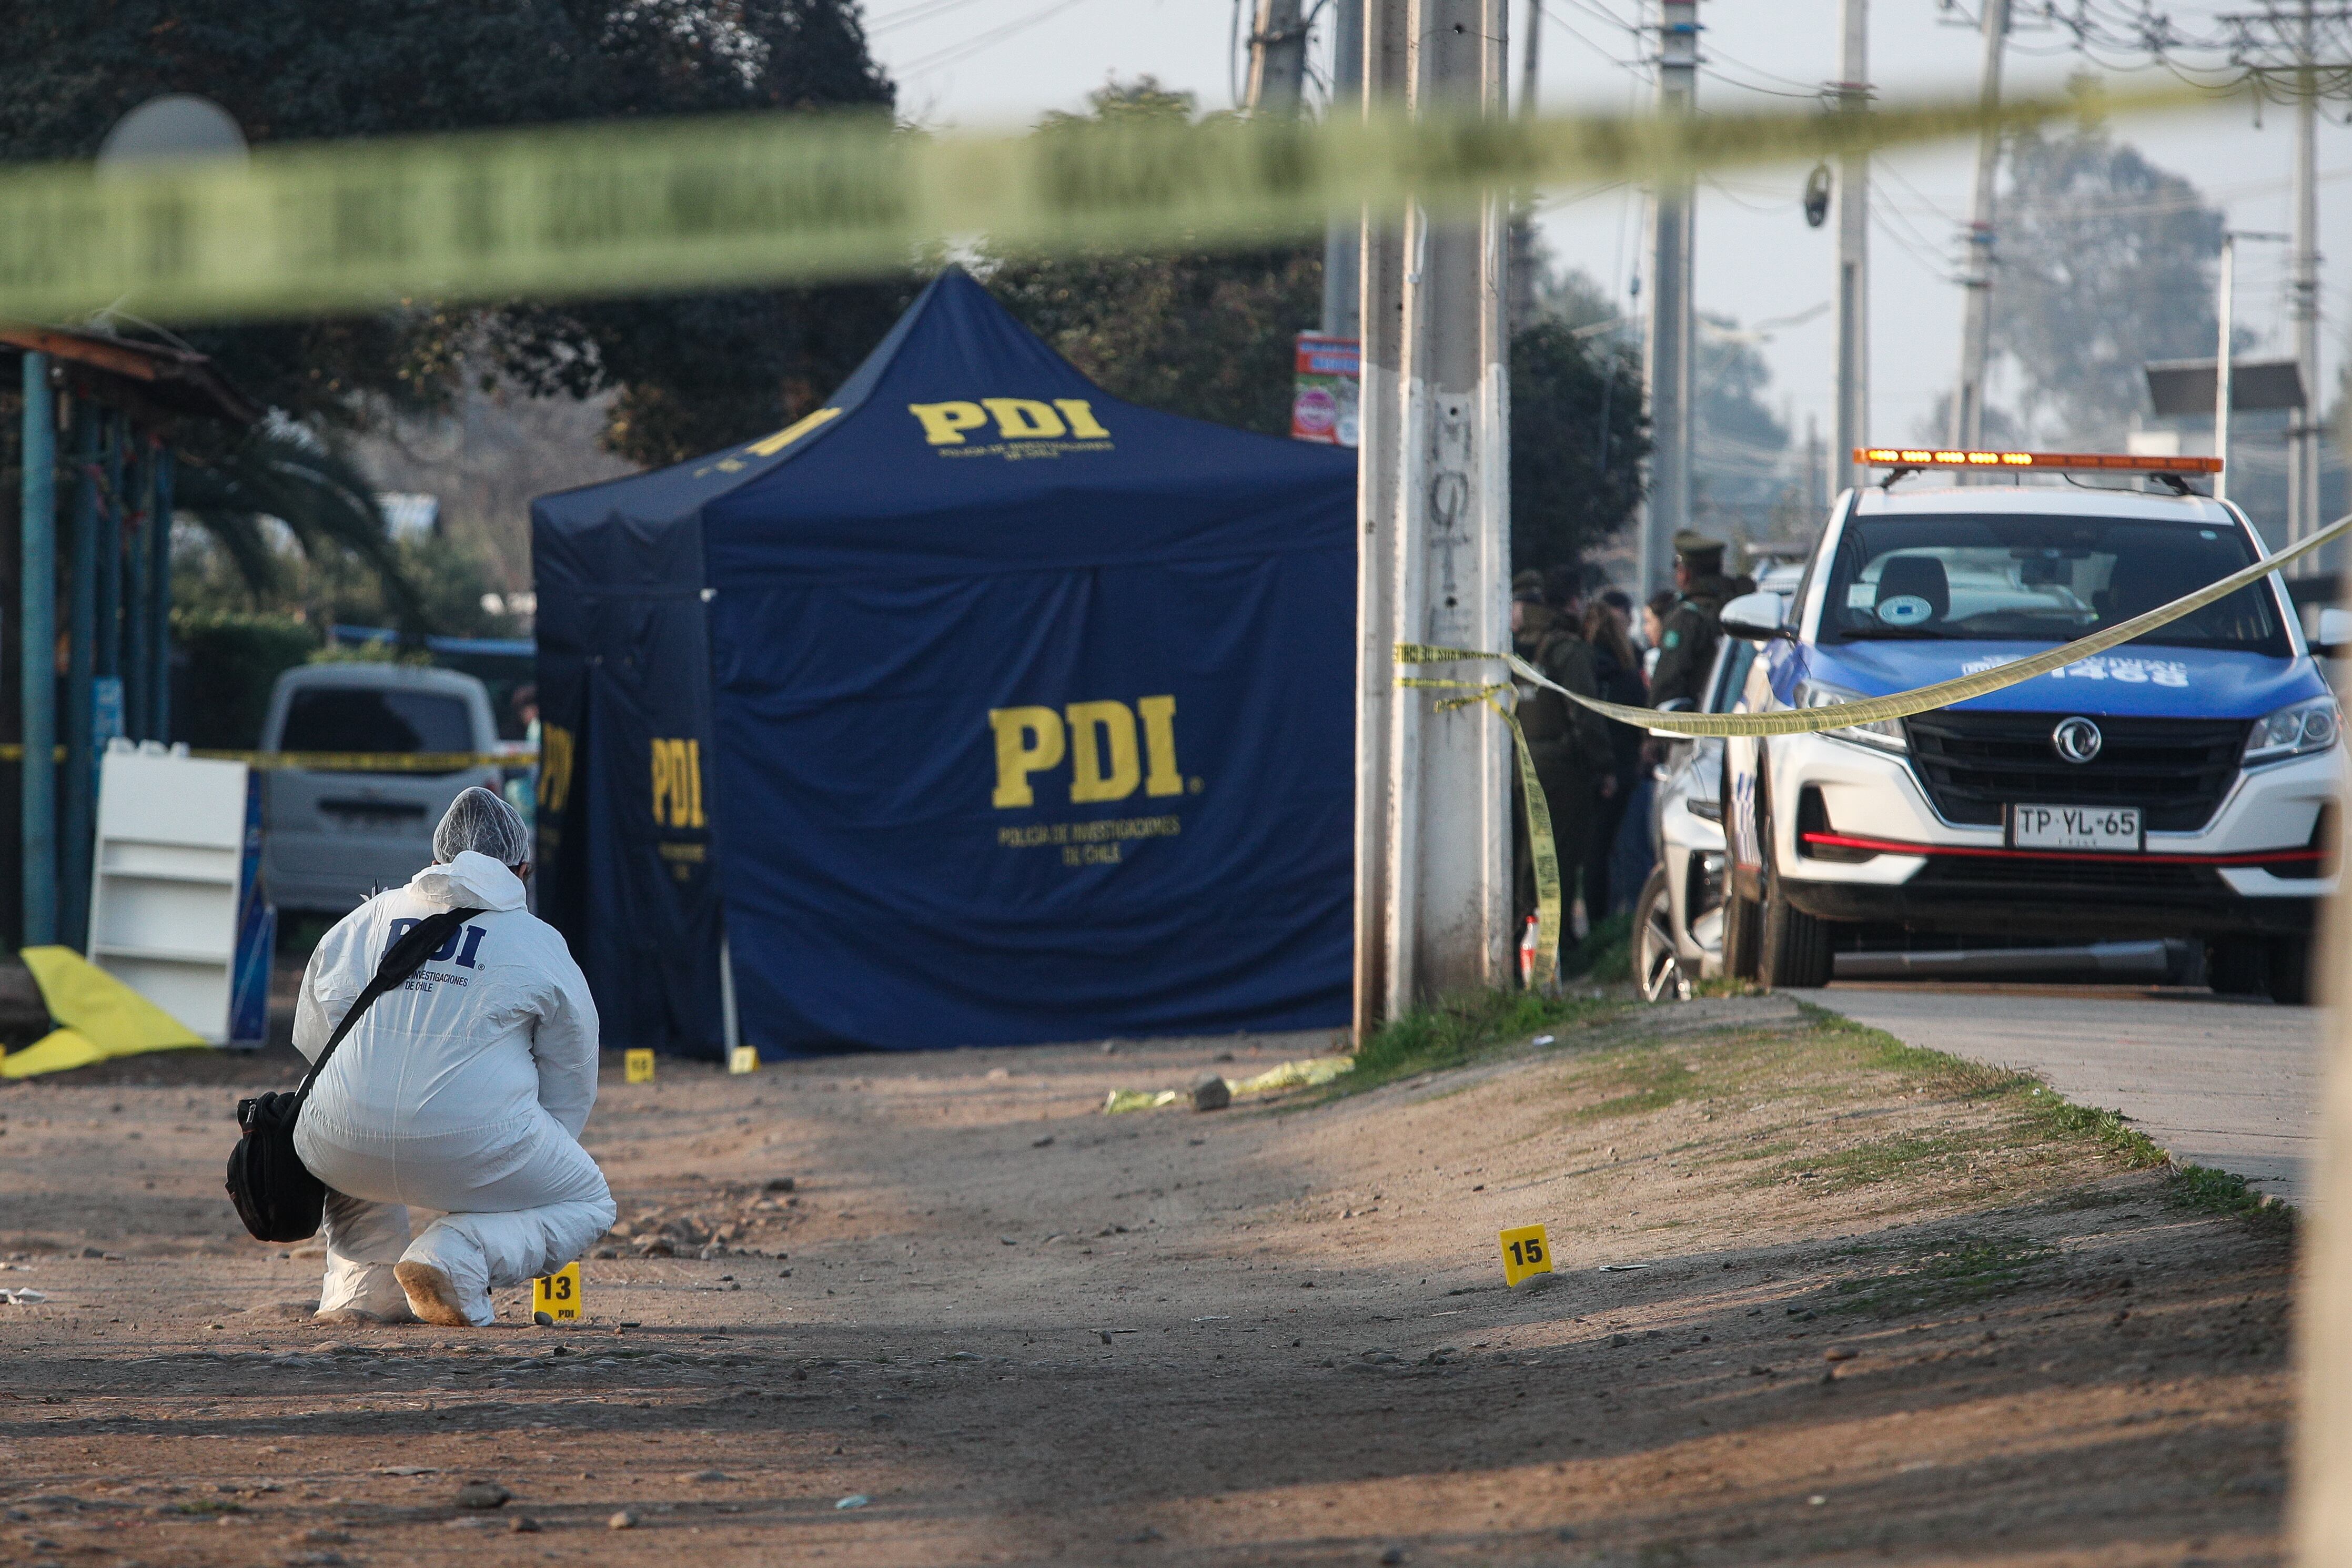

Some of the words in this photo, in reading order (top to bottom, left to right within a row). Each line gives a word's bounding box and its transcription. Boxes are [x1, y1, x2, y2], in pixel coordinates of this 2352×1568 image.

[908, 398, 1111, 446] PDI
[989, 695, 1184, 809] PDI
[651, 737, 705, 828] PDI
[405, 980, 415, 990] DE
[416, 982, 433, 993] CHILE
[412, 970, 469, 987] INVESTIGACIONES
[1509, 1239, 1543, 1266] 15
[541, 1277, 571, 1300] 13
[558, 1309, 574, 1318] PDI
